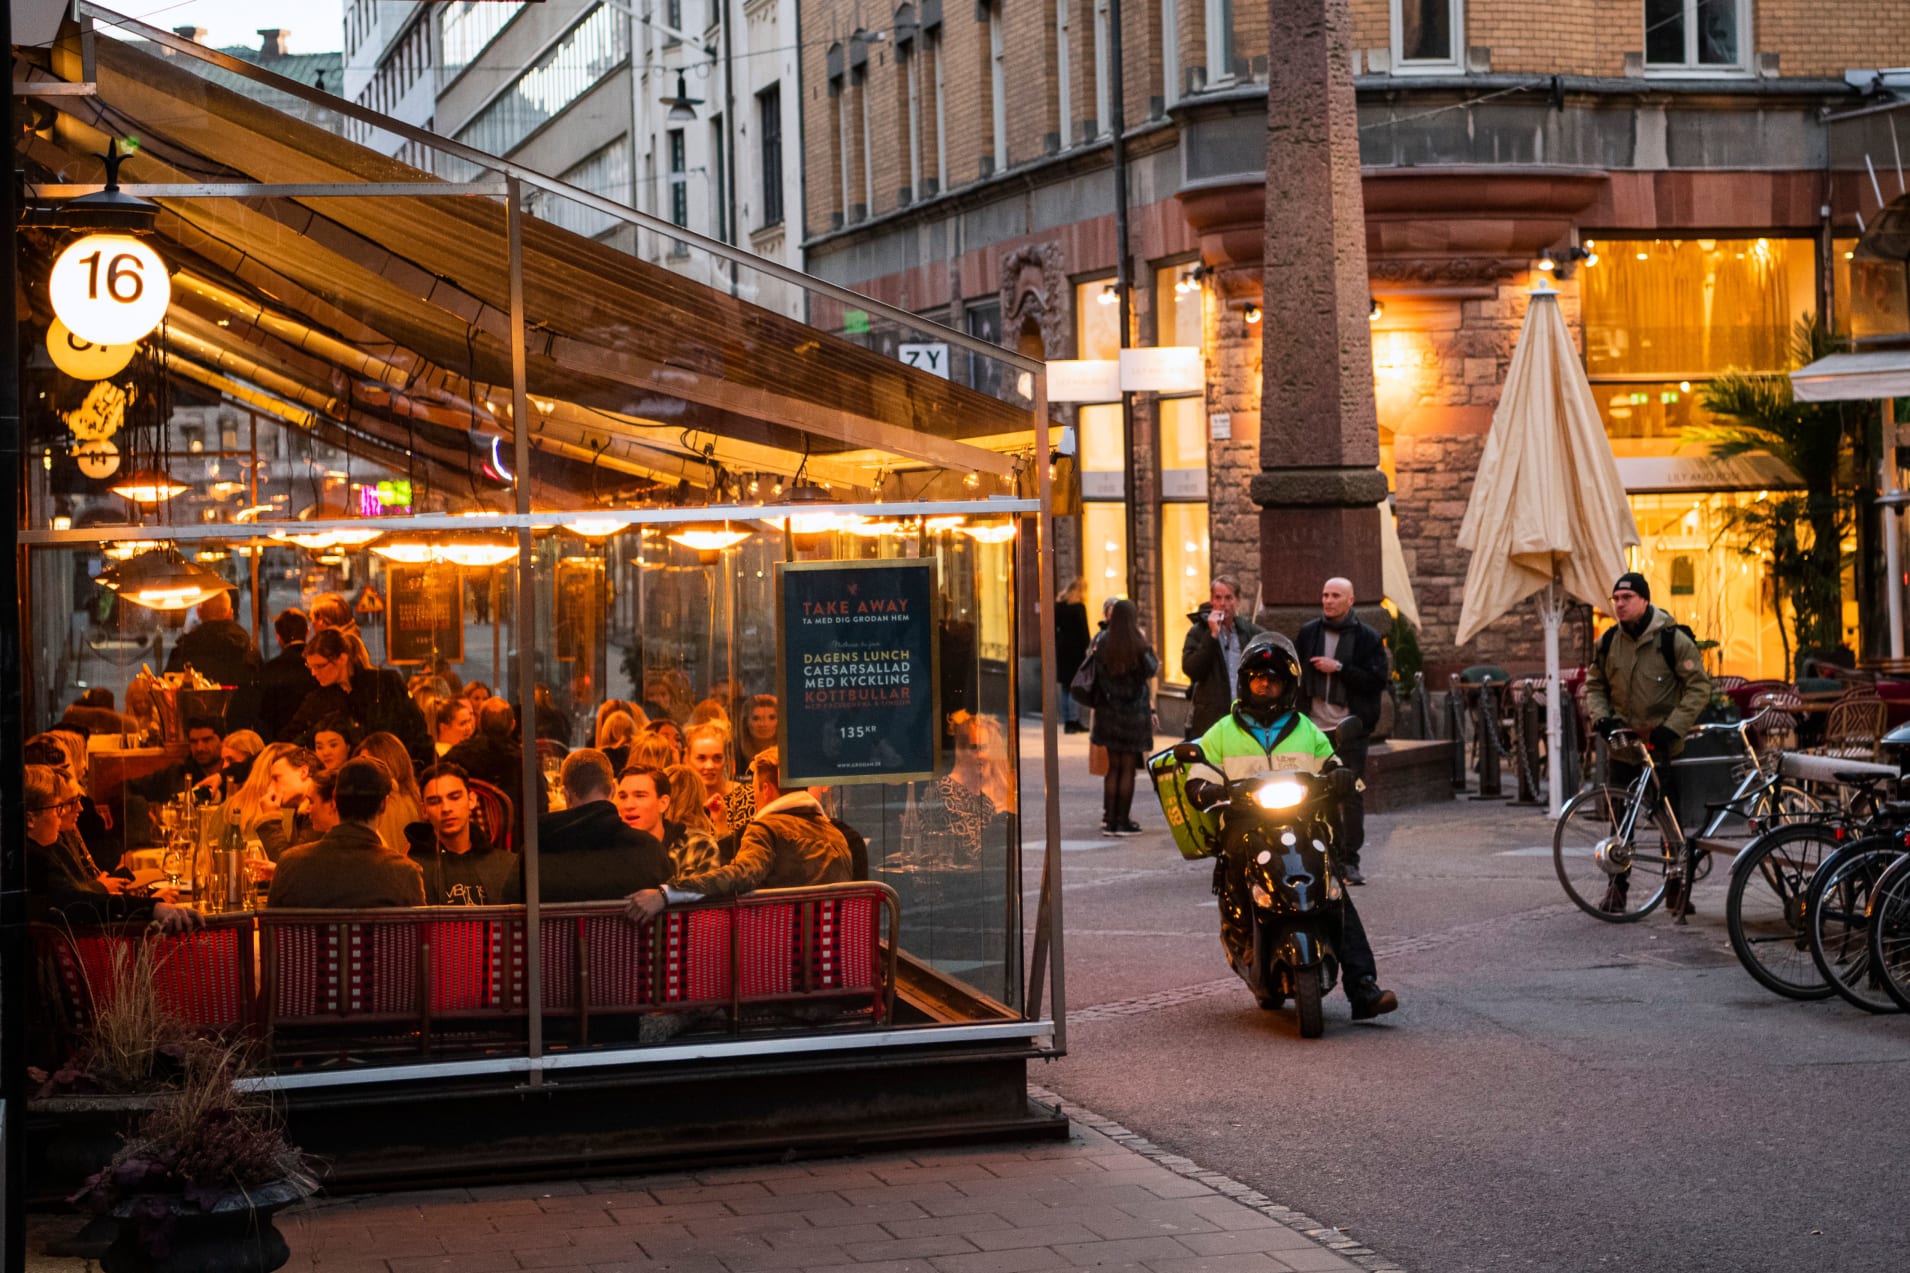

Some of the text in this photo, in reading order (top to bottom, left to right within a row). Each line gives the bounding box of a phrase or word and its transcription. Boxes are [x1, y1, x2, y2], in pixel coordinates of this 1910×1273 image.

[78, 250, 145, 304] 16
[1667, 471, 1687, 482] LILY
[1690, 471, 1714, 481] AND
[802, 599, 909, 615] TAKE AWAY
[853, 615, 889, 623] GRODAN
[804, 650, 910, 664] DAGENS LUNCH
[803, 662, 911, 676] CAESARSALLAD
[805, 675, 910, 688] MED KYCKLING
